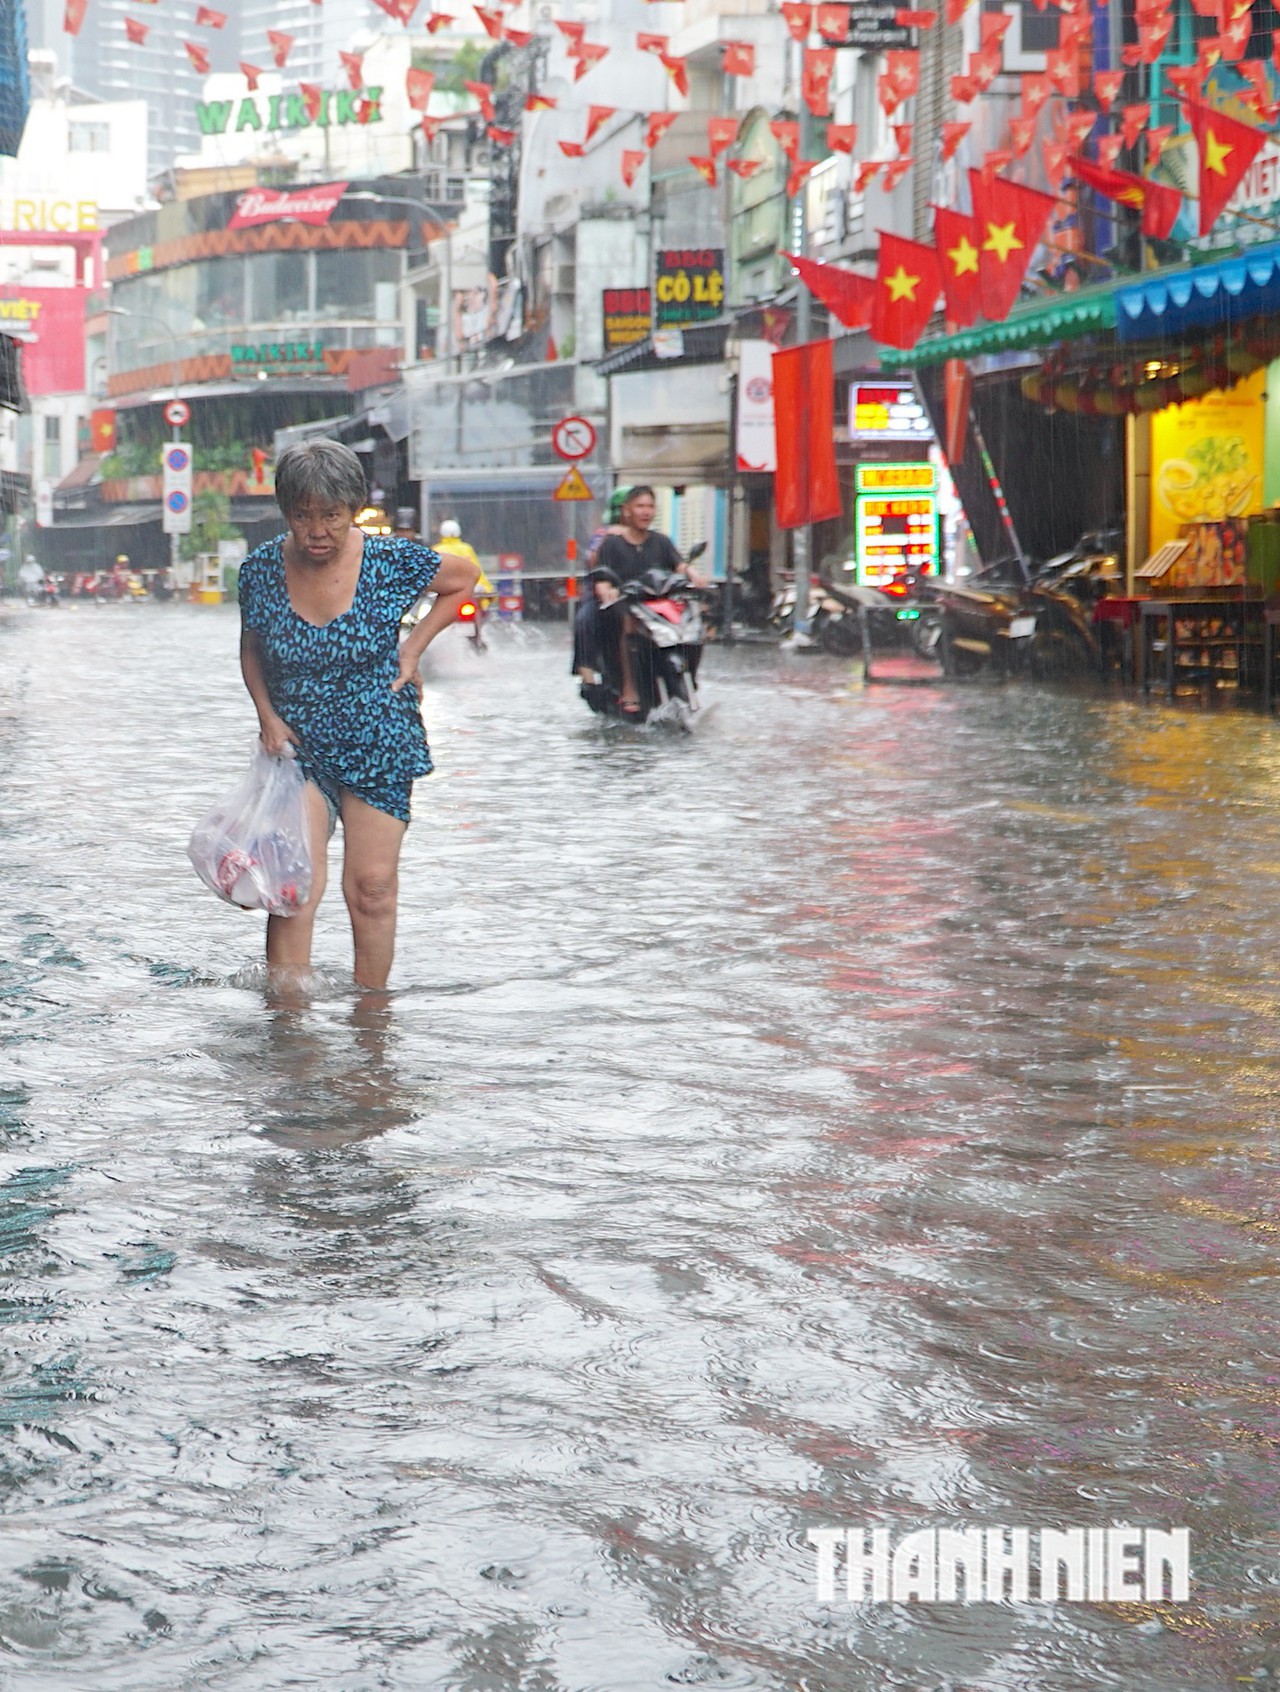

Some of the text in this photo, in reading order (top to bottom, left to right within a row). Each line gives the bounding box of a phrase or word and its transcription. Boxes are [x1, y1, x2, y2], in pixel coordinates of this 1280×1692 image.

[195, 86, 384, 134] WAIKIKI
[13, 200, 98, 231] RICE
[237, 191, 337, 217] Budweiser
[657, 269, 690, 302] CÔ
[231, 341, 323, 362] WAIKIKI
